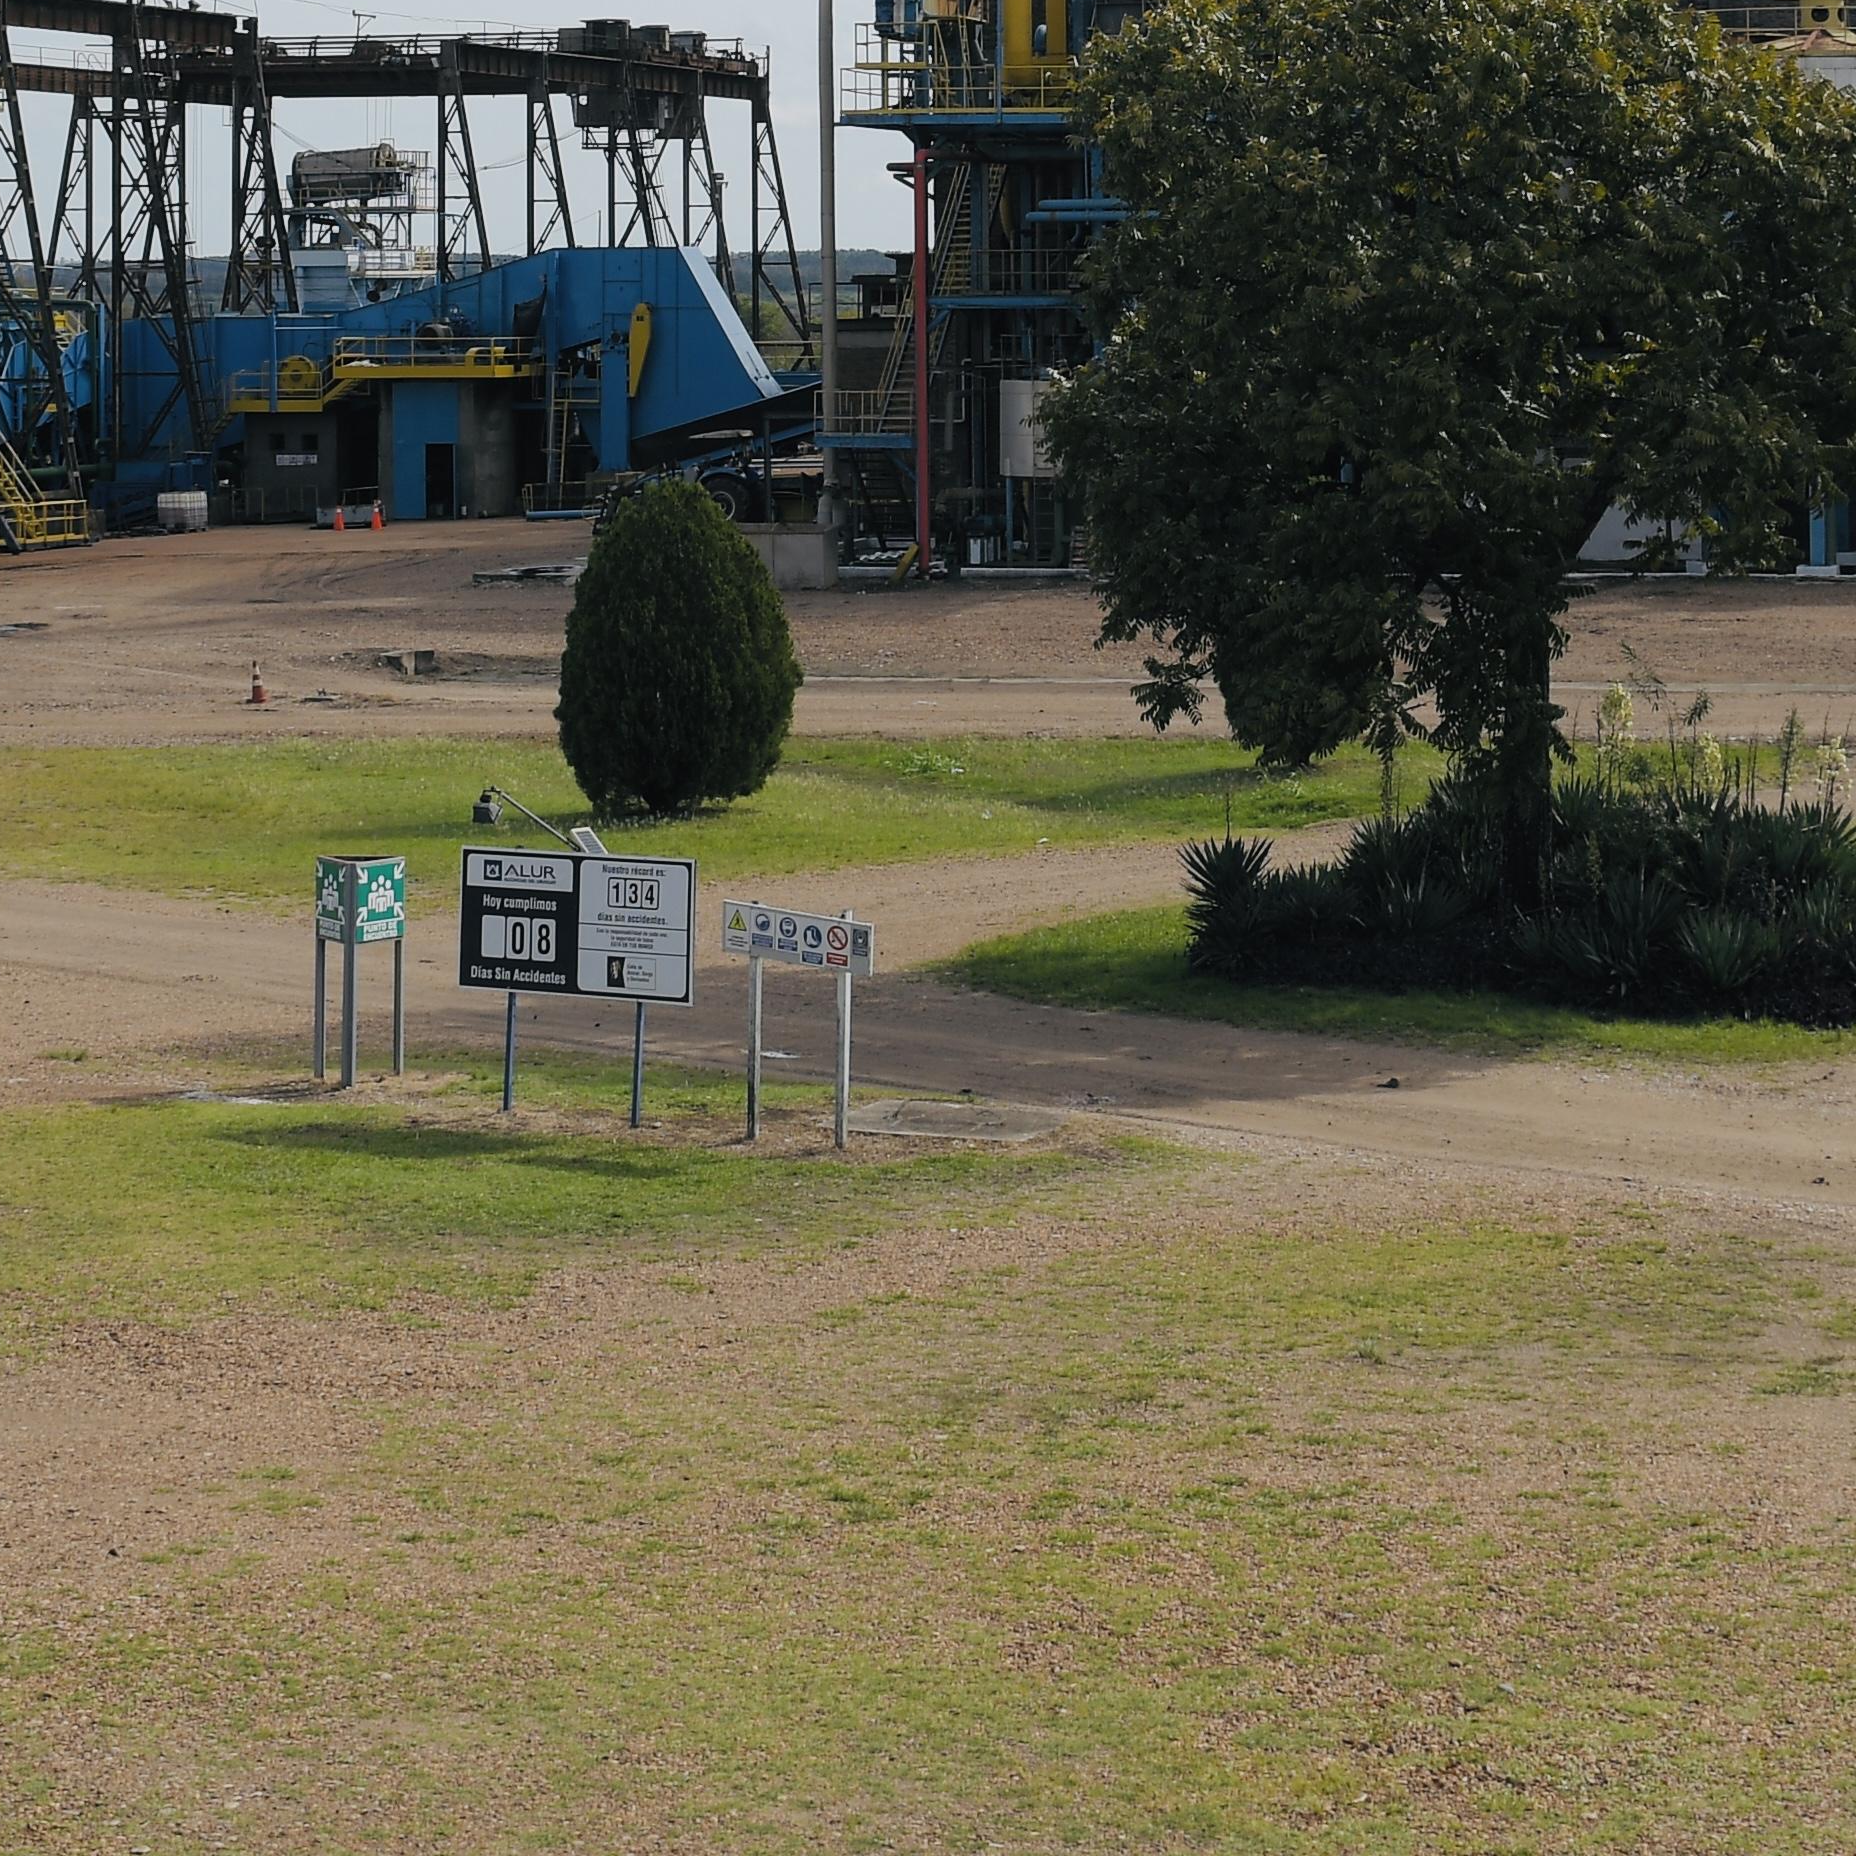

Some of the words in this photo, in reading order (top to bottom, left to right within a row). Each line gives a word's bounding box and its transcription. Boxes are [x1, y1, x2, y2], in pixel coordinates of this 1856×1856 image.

[504, 864, 556, 879] ALUR
[602, 864, 629, 875] Nuestro
[482, 894, 501, 910] Hoy
[504, 897, 557, 912] cumplimos
[612, 882, 655, 905] 134
[512, 922, 550, 955] 08
[470, 965, 493, 979] Días
[495, 967, 511, 980] Sin
[513, 969, 566, 985] Accidentes
